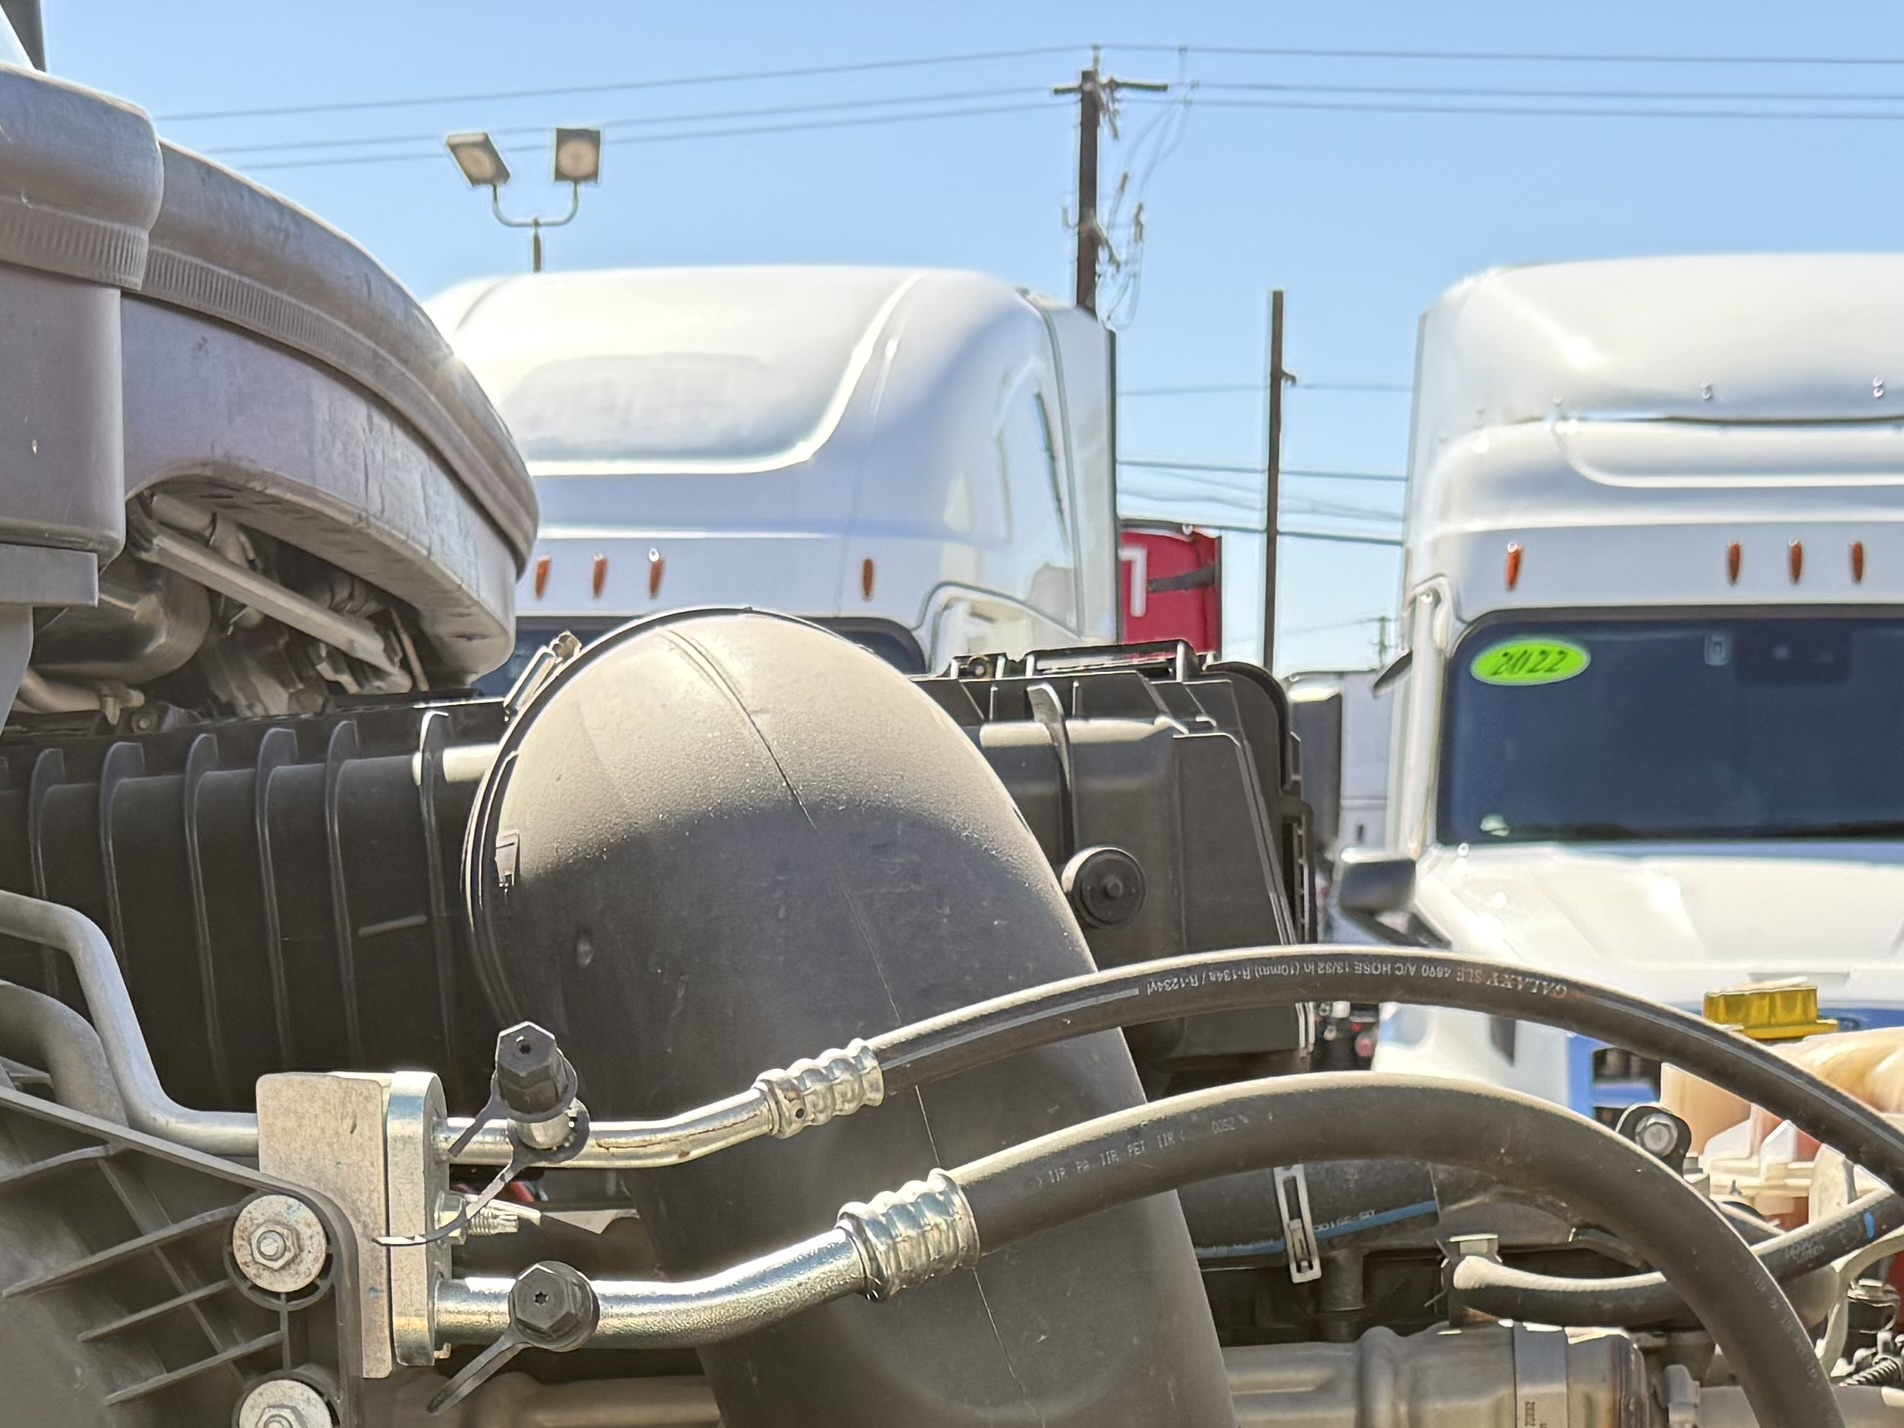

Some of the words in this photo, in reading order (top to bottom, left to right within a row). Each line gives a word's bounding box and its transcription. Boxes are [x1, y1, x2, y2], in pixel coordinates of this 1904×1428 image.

[1493, 644, 1571, 679] 2022
[1253, 961, 1300, 979] (10mm)
[1353, 961, 1392, 975] HOSE
[1394, 962, 1417, 978] A/C
[1486, 971, 1568, 999] GALAXY
